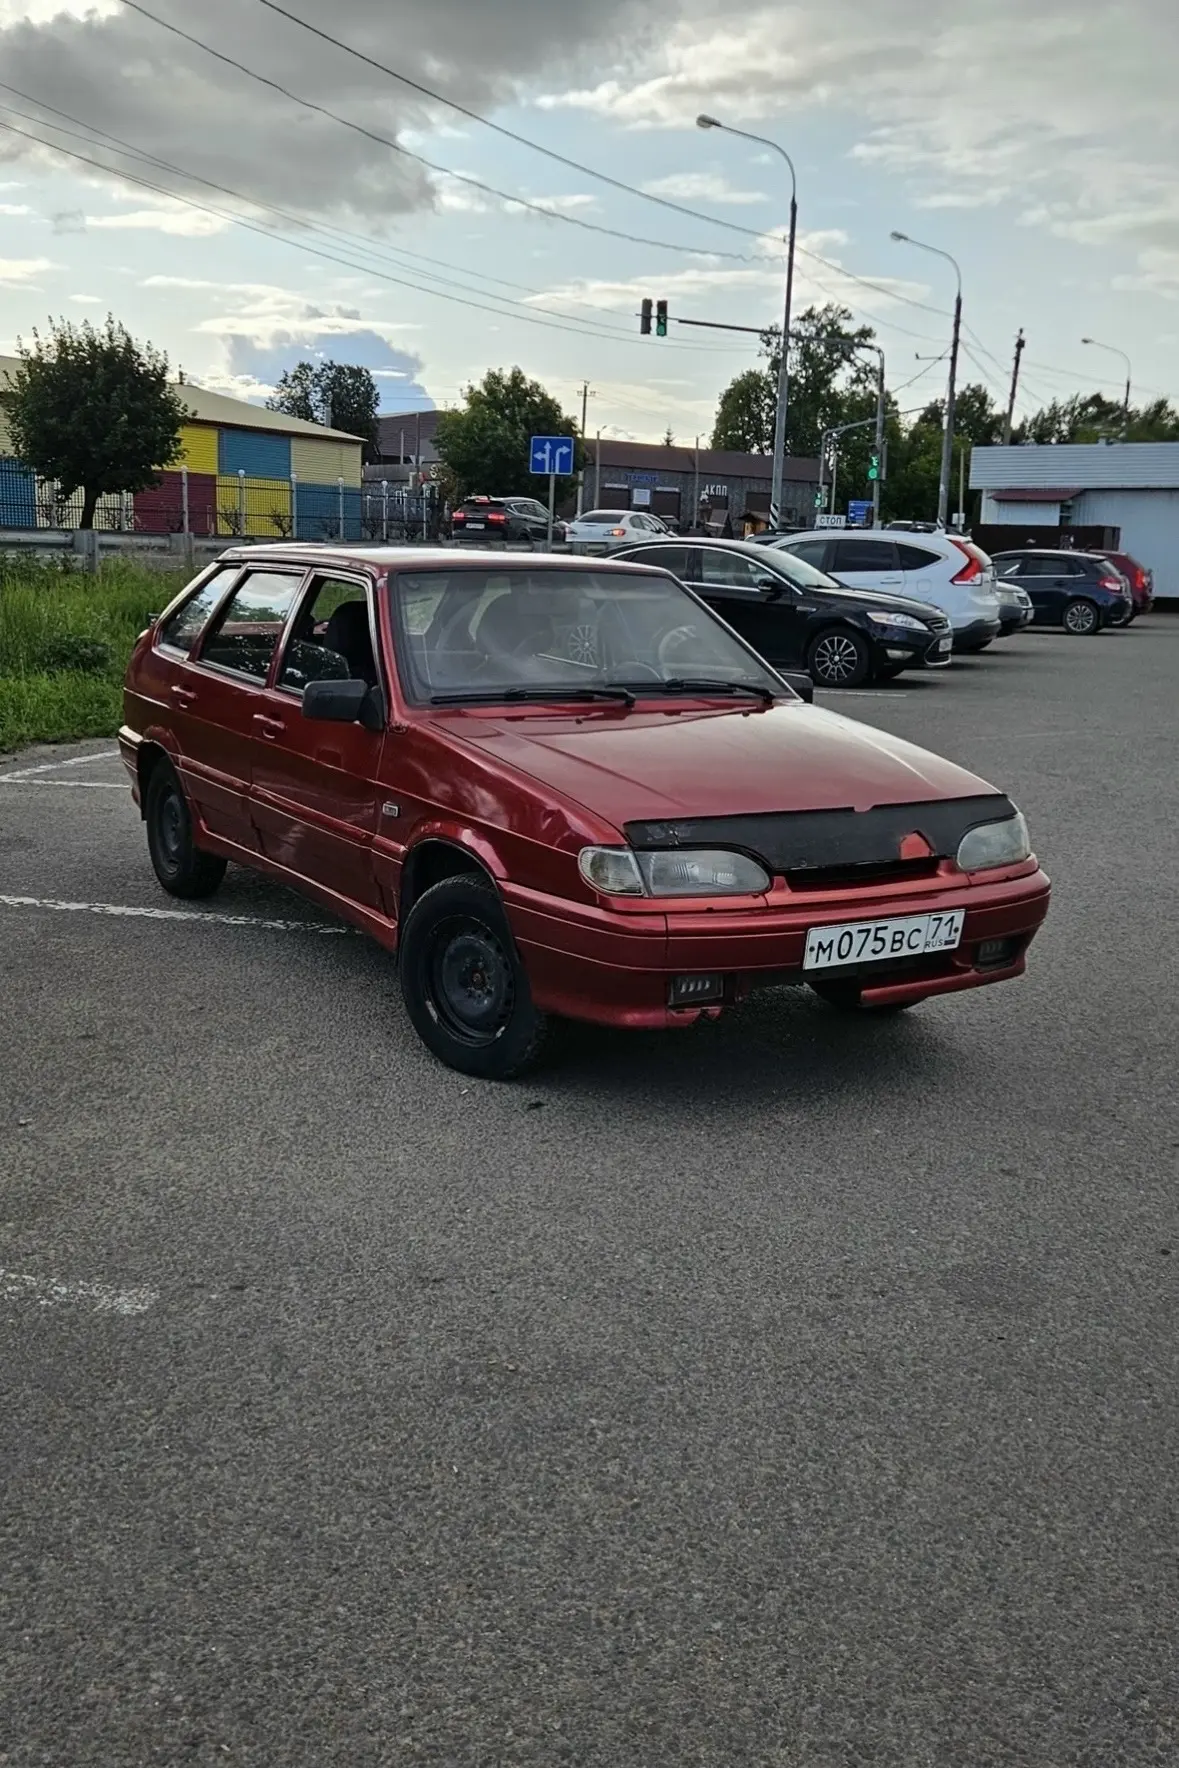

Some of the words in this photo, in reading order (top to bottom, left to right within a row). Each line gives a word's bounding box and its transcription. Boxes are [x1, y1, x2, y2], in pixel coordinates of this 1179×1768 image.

[705, 484, 728, 496] АКПП
[820, 516, 842, 525] СТОП
[815, 926, 922, 963] М075ВС
[931, 916, 955, 939] 71
[925, 939, 944, 949] RUS
